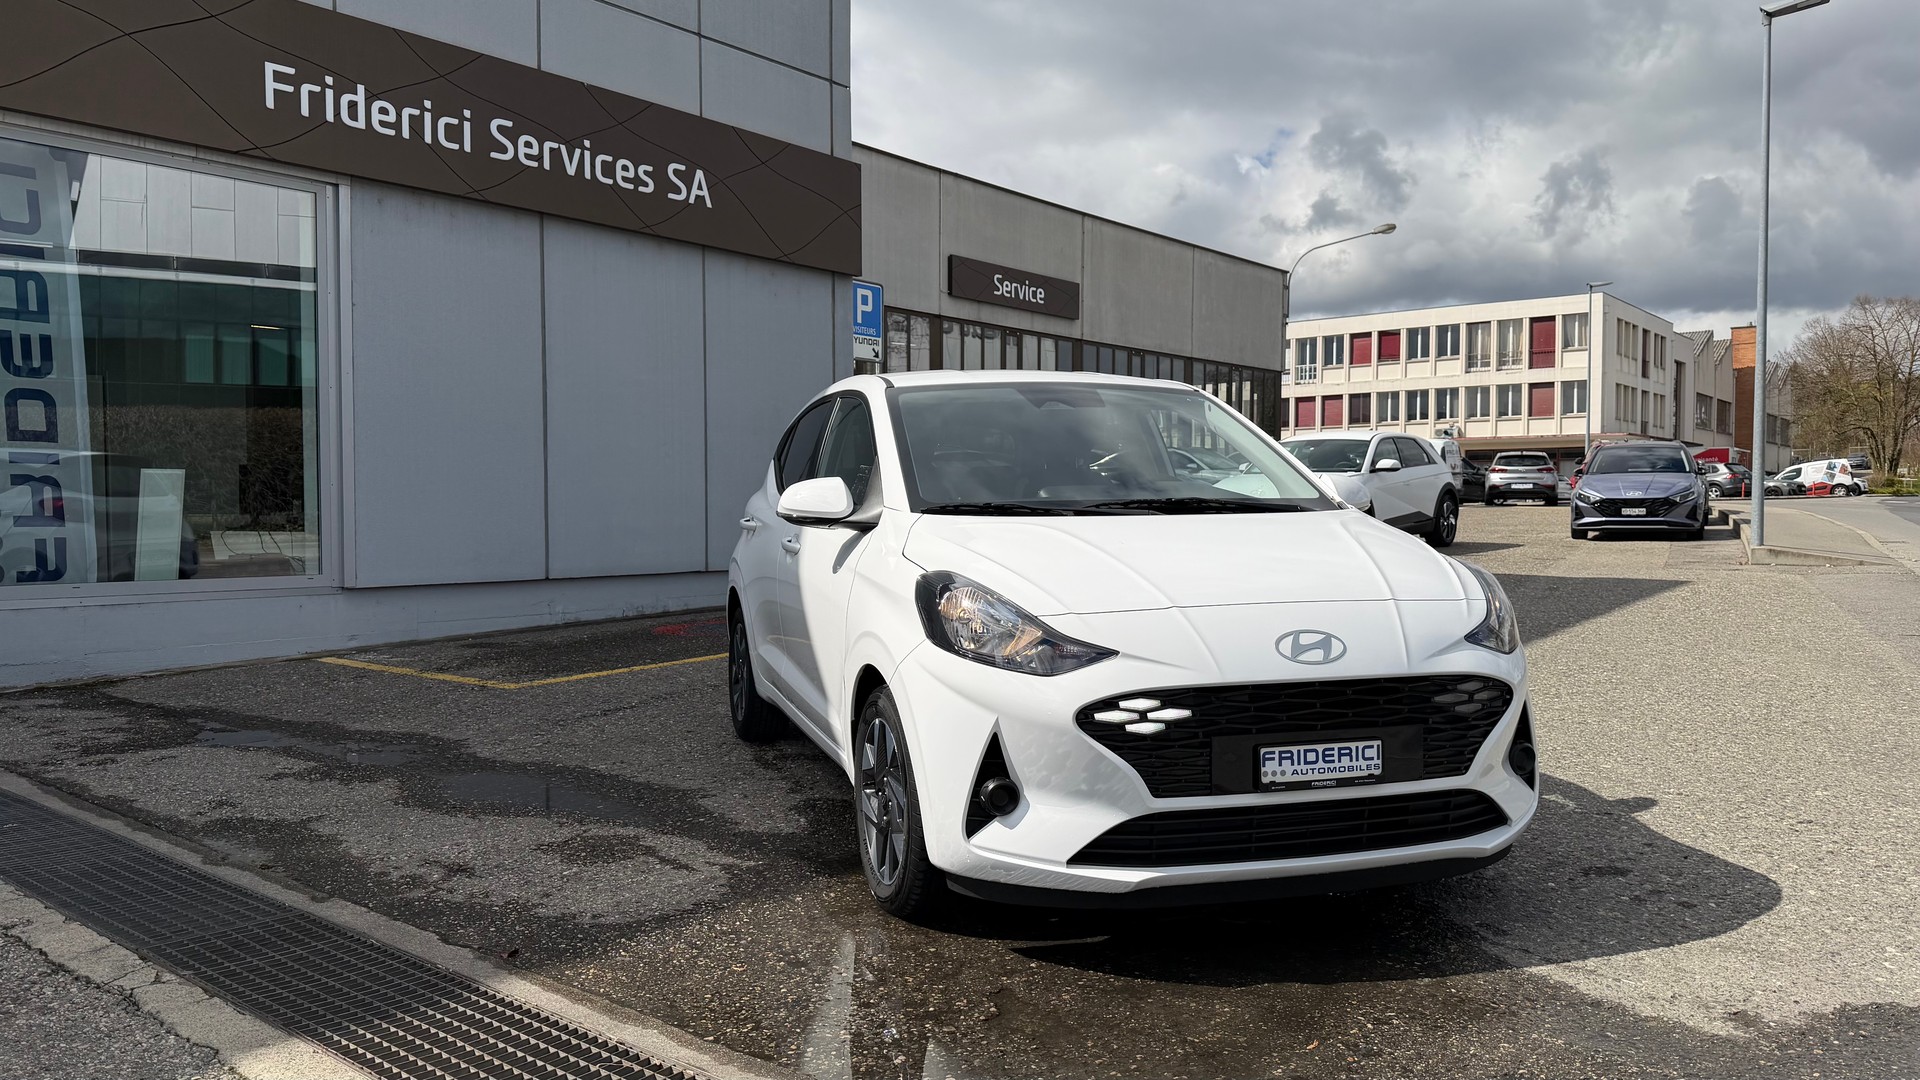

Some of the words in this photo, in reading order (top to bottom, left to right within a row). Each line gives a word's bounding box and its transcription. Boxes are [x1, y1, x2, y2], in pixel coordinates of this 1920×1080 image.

[264, 61, 472, 153] Friderici
[489, 118, 654, 194] Services
[667, 162, 713, 209] SA
[993, 274, 1045, 304] Service
[857, 288, 873, 324] P
[853, 325, 877, 336] VISITEURS
[853, 335, 880, 347] YUNDAI
[1261, 744, 1381, 768] FRIDERICI
[1290, 763, 1381, 776] AUTOMOBILES
